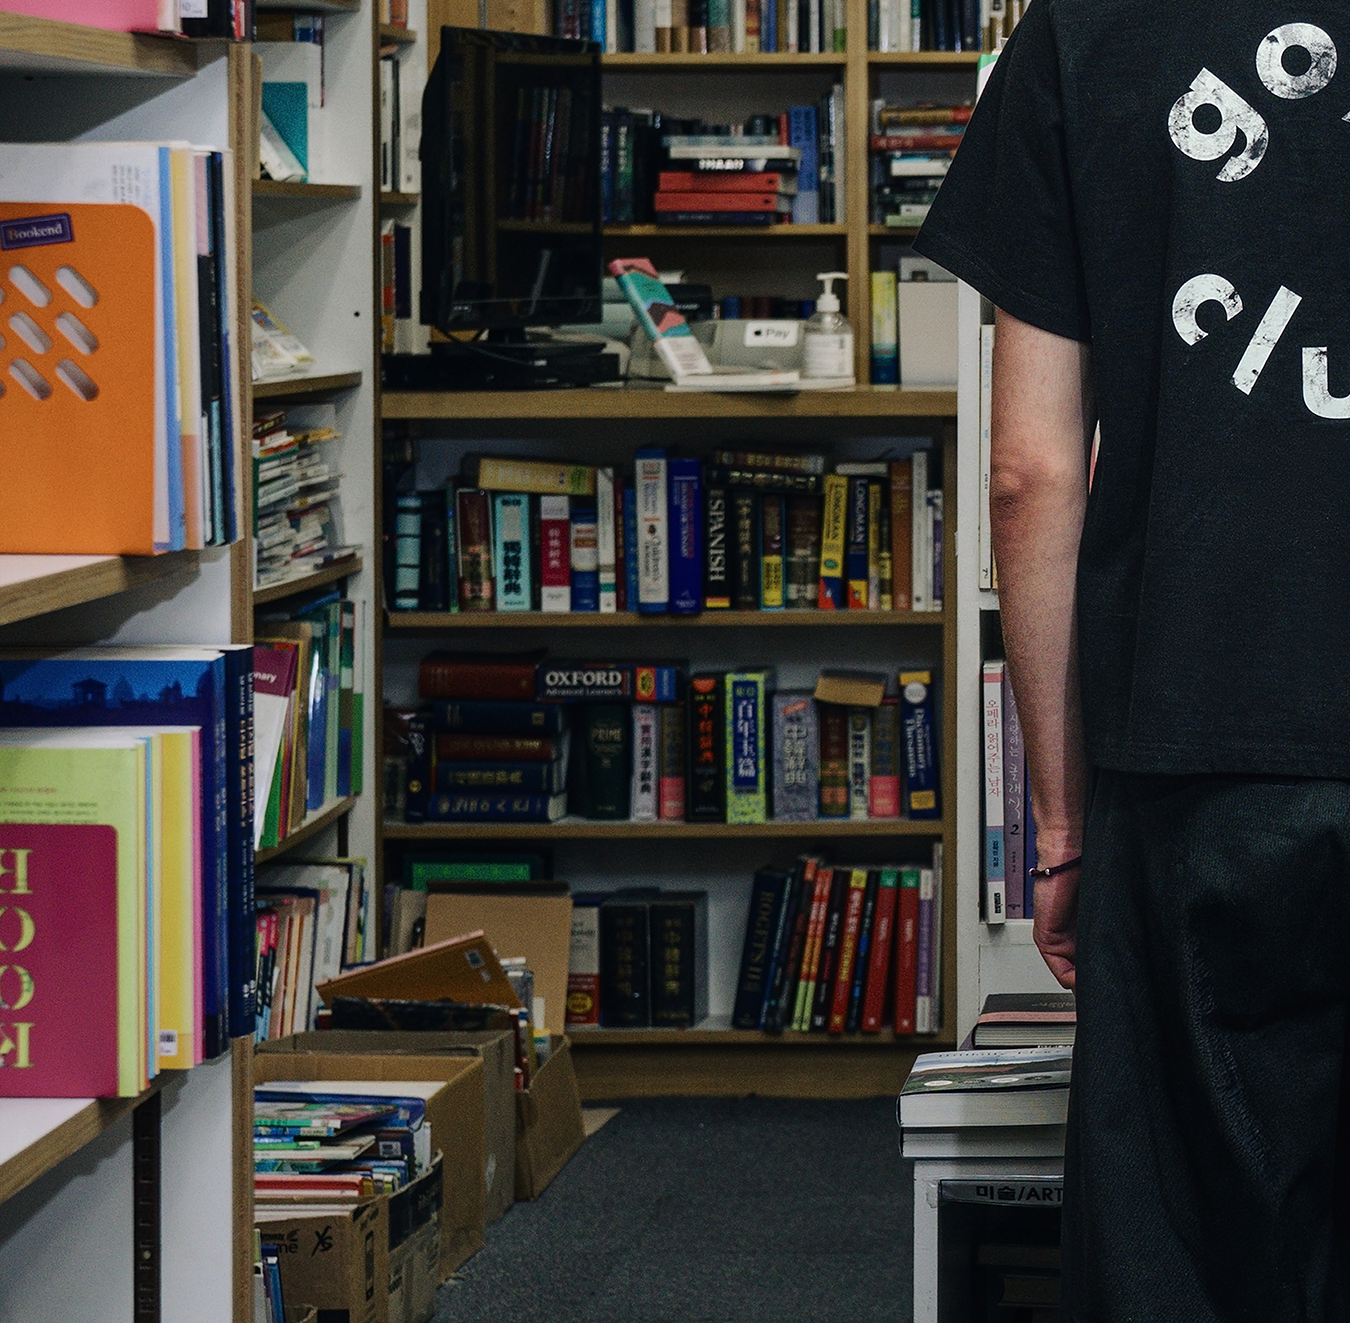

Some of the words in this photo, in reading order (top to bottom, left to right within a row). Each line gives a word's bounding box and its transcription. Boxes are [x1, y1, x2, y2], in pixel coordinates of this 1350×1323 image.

[7, 223, 63, 241] Bookend
[765, 327, 791, 342] Pay
[709, 497, 727, 583] SPANISH
[545, 670, 623, 687] OXFORD
